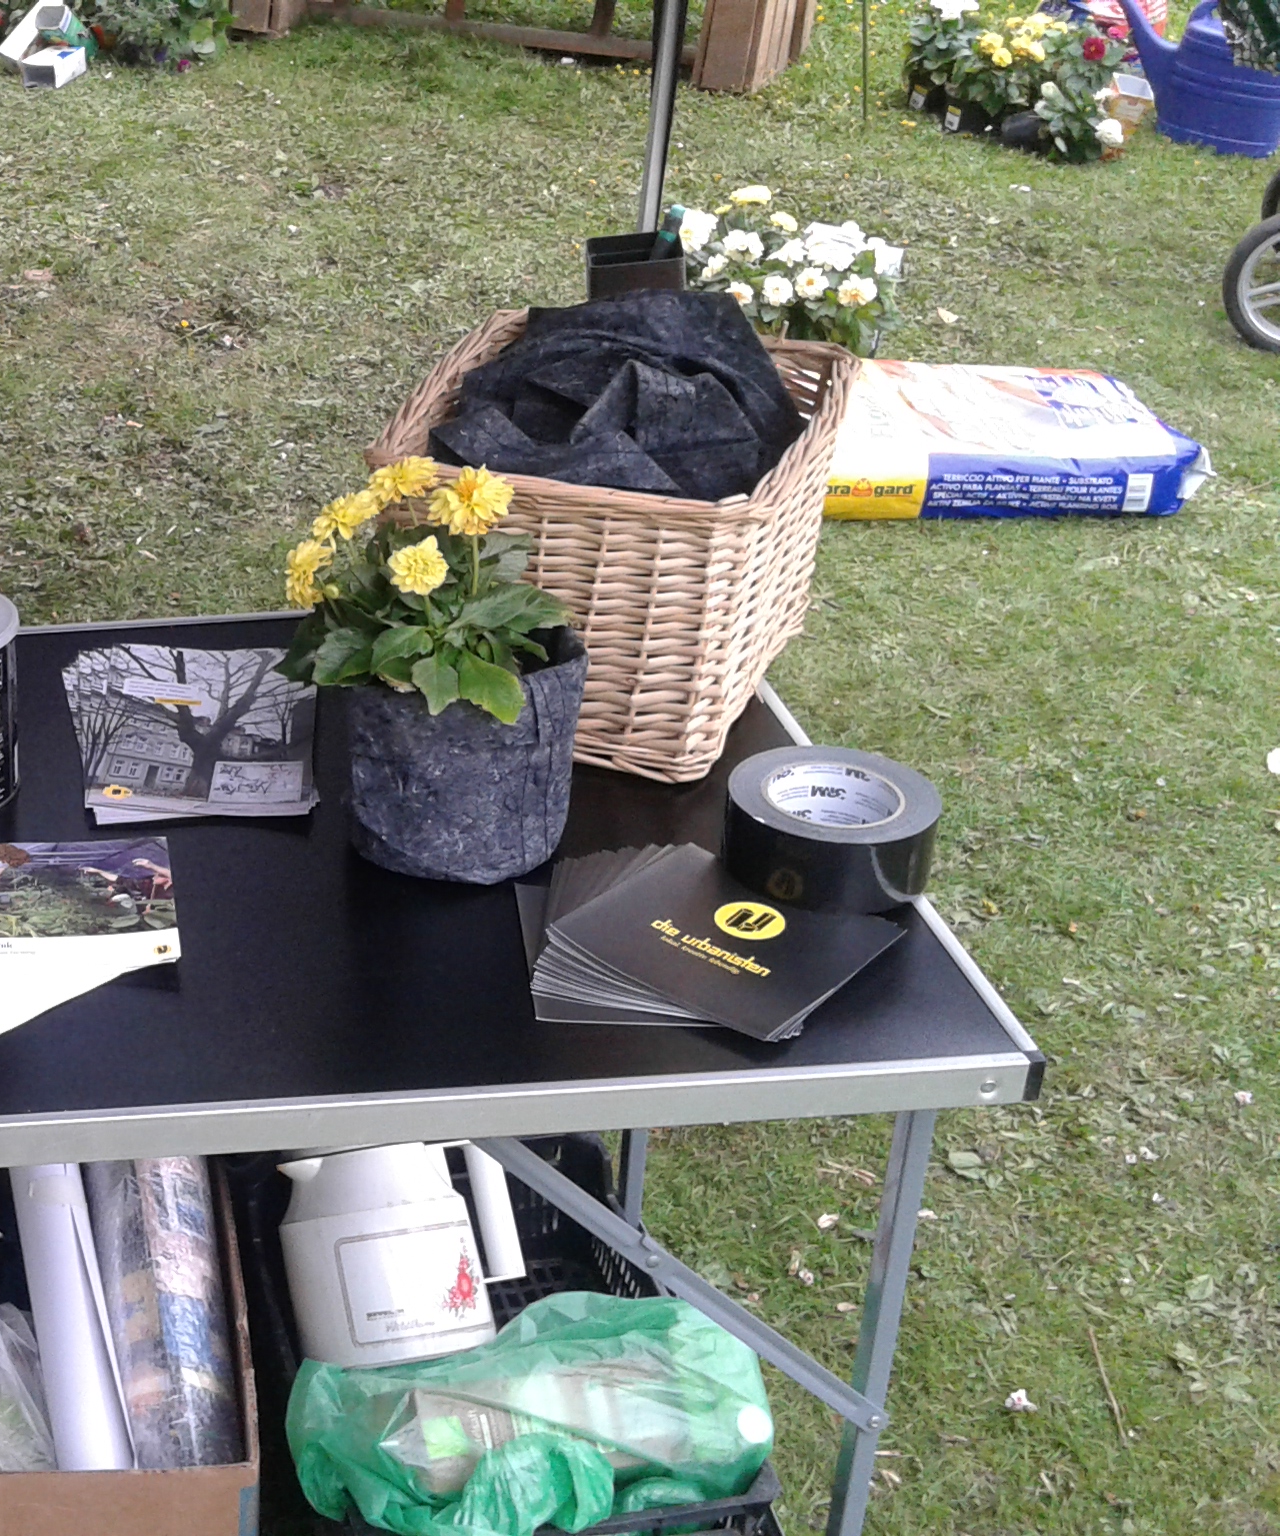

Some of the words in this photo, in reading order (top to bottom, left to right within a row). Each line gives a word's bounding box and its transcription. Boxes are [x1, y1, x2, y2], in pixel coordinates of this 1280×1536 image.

[1068, 476, 1113, 485] SUBSTRATO
[826, 484, 851, 495] ora
[929, 483, 961, 491] ACTIVO
[1065, 485, 1088, 494] POUR
[810, 785, 847, 800] 3M
[650, 919, 681, 937] die
[681, 934, 771, 977] urbanisten
